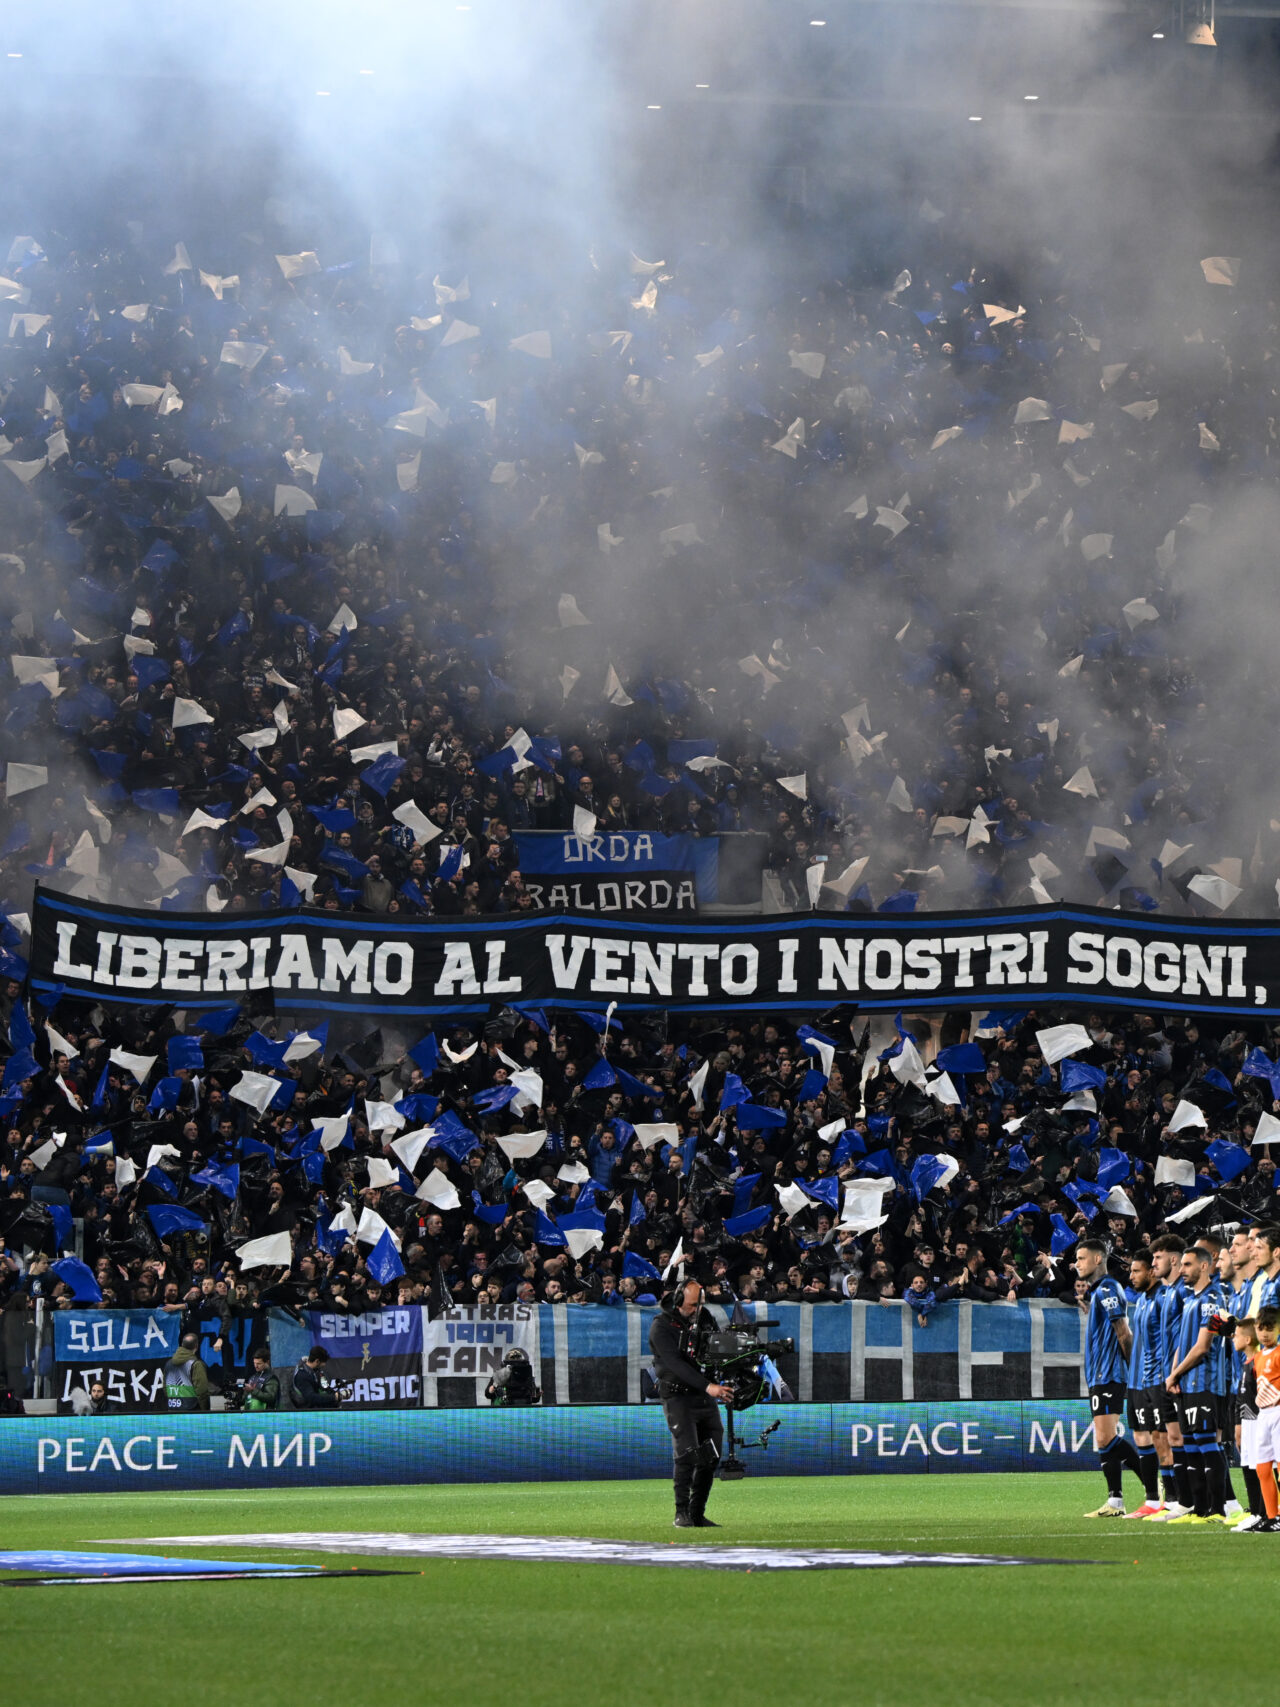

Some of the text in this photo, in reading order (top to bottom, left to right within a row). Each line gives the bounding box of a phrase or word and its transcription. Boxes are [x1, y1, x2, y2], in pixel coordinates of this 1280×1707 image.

[563, 834, 653, 862] ORDA
[53, 921, 414, 995] LIBERIAMO
[434, 940, 521, 995] AL
[545, 934, 758, 996] VENTO
[778, 938, 799, 993] I
[818, 931, 1048, 991] NOSTRI
[1066, 932, 1267, 1005] SOGNI,
[67, 1316, 169, 1353] SOLA
[320, 1310, 410, 1338] SEMPER
[446, 1323, 513, 1344] 1907
[169, 1386, 180, 1396] TV
[38, 1436, 178, 1473] PEACE
[851, 1422, 982, 1457] PEACE
